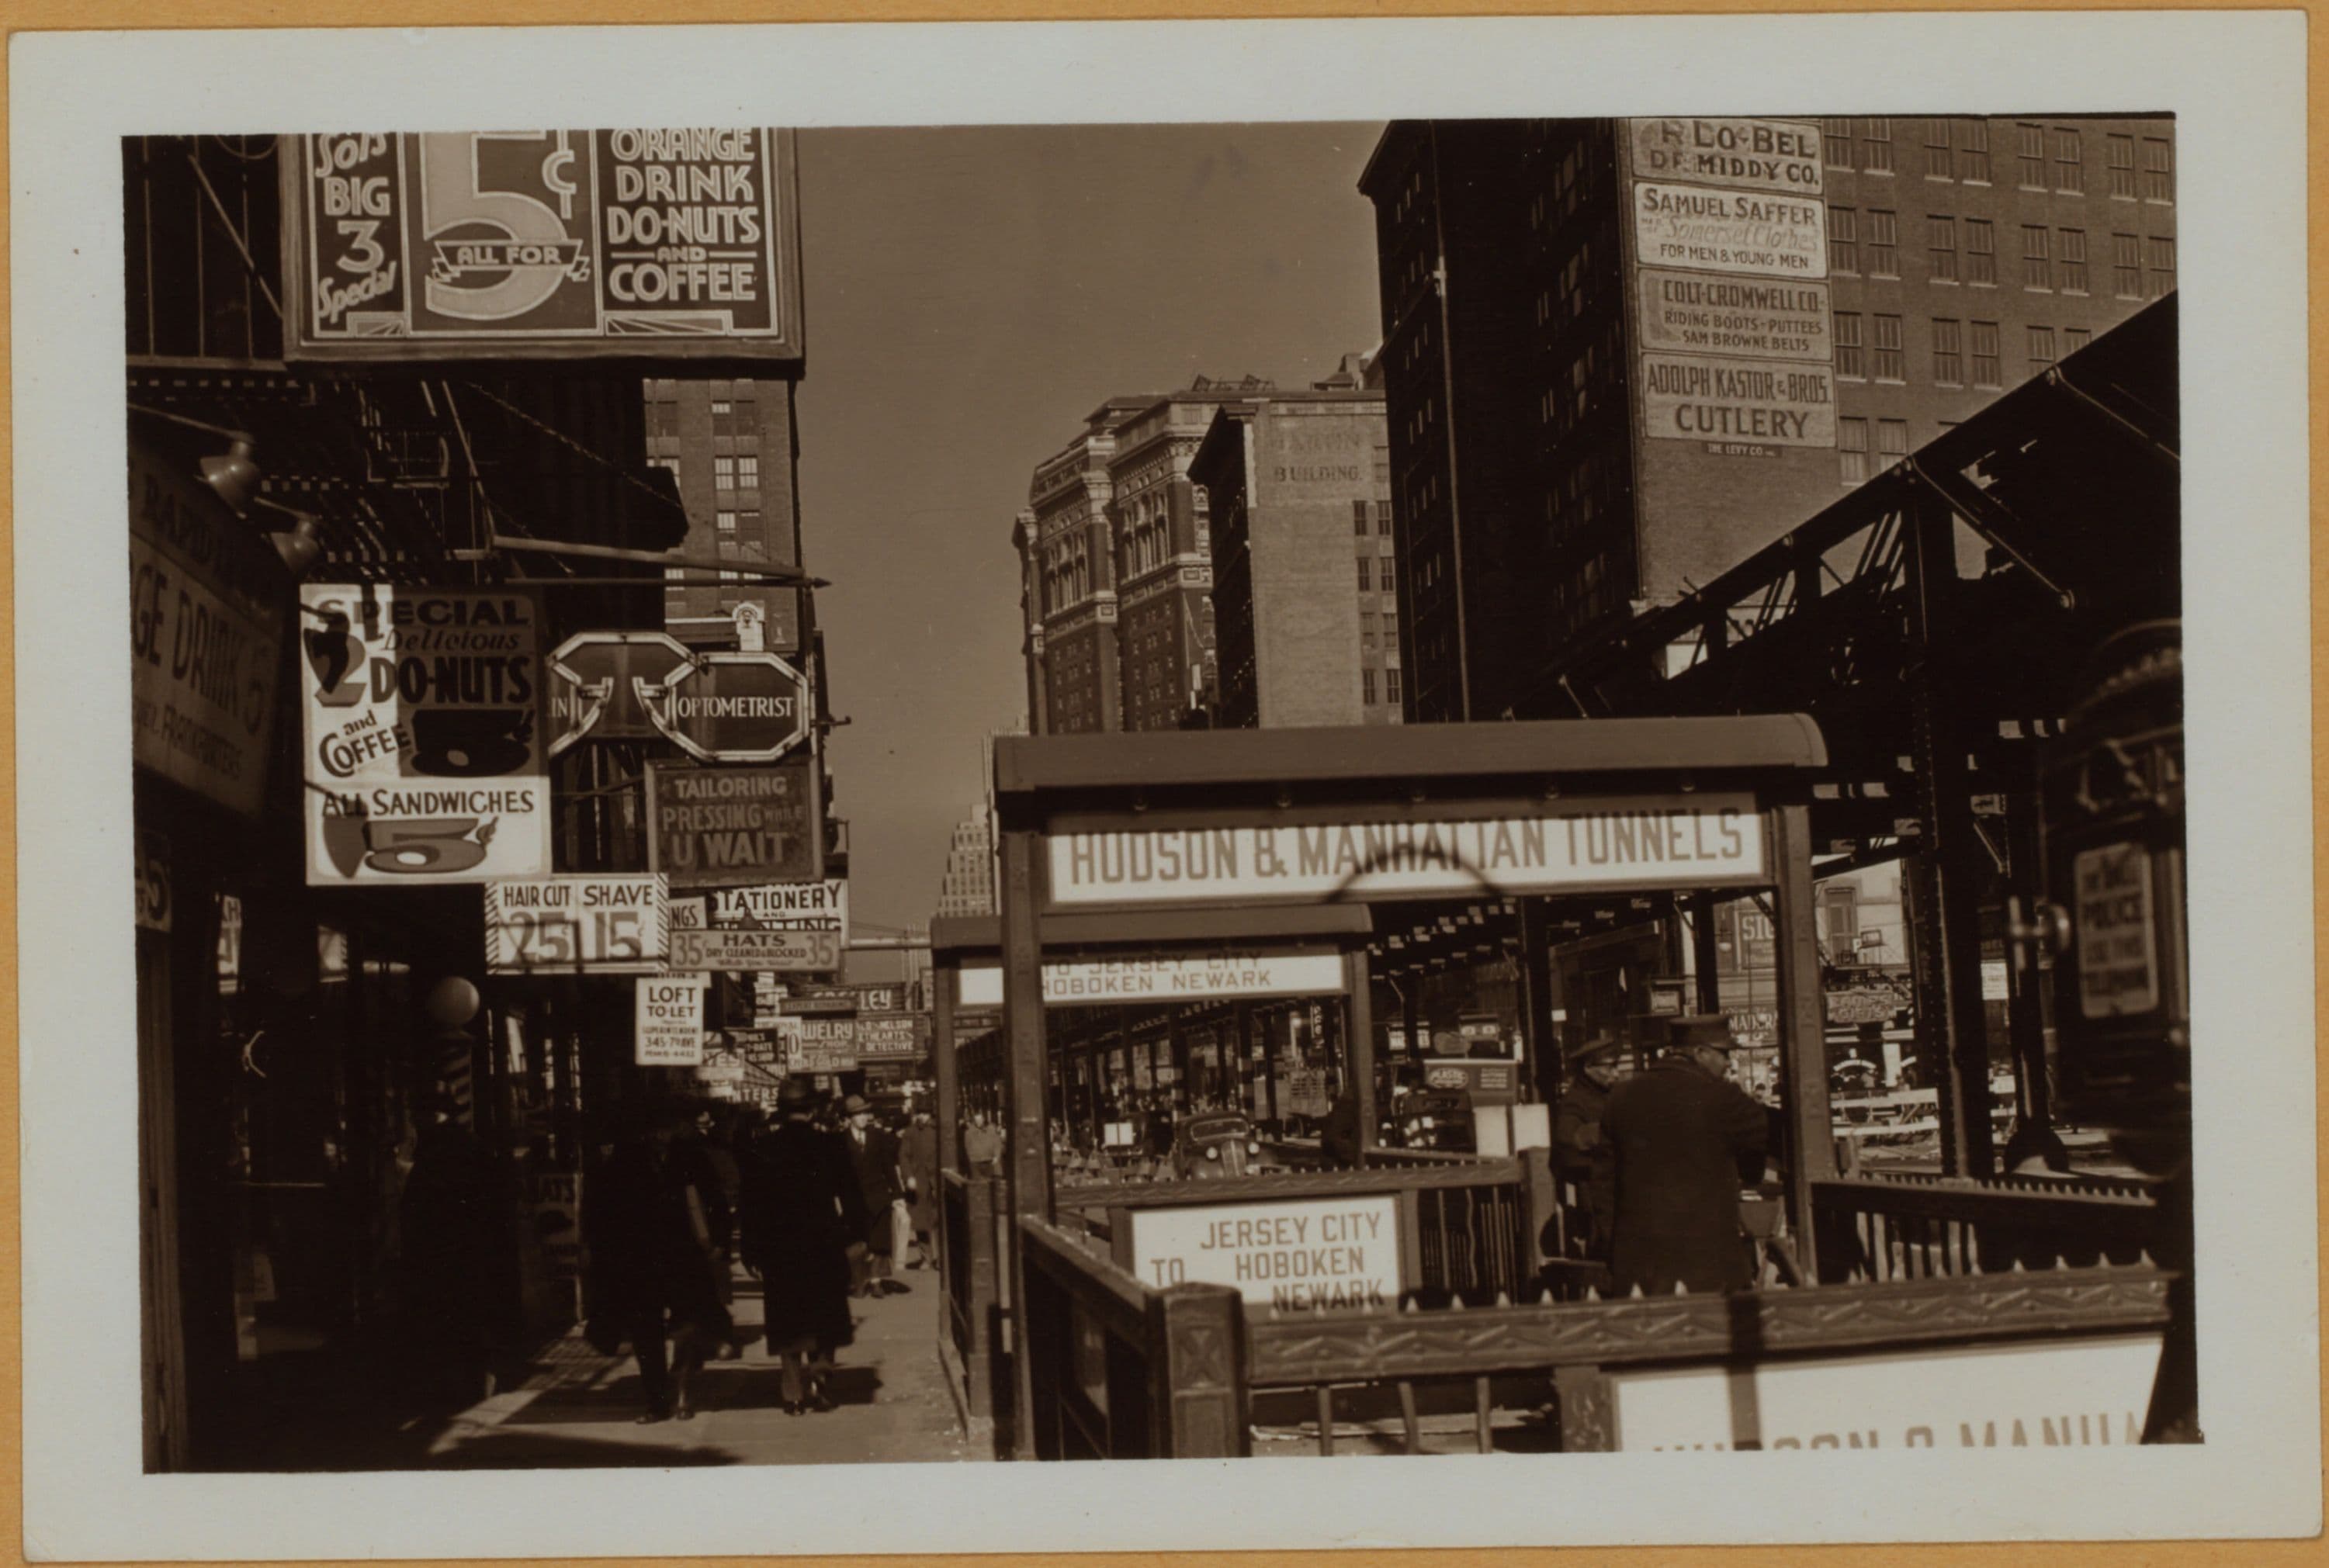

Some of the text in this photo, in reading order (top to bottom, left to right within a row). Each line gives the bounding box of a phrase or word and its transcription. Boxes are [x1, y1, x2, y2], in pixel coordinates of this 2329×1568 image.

[609, 130, 756, 161] ORANGE
[616, 165, 754, 202] DRINK
[1697, 154, 1780, 181] MIDDY
[1787, 163, 1820, 186] CO.
[324, 176, 390, 216] BIG
[1642, 188, 1817, 227] SAMUEL SAFFER
[337, 220, 385, 273] 3
[456, 246, 561, 265] ALL FOR
[656, 246, 707, 263] AND
[1660, 244, 1809, 270] FOR MEN & YOUNG MEN
[318, 261, 397, 324] Special
[609, 264, 756, 301] COFFEE
[1665, 310, 1710, 327] RIDING
[1683, 330, 1810, 354] SAM BROWNE BELTS
[1646, 362, 1710, 396] ADOLPH
[1714, 367, 1777, 401] KASTOR
[1674, 403, 1810, 440] CUTLERY
[318, 599, 529, 626] SPECIAL
[383, 629, 519, 652] Delicious
[369, 656, 532, 704] DO-NUTS
[676, 697, 794, 718] OPTOMETRIST
[342, 709, 378, 736] and
[319, 723, 414, 777] COFFEE
[673, 776, 787, 800] TAILORING
[322, 788, 534, 818] ALL SANDWICHES
[662, 804, 762, 831] PRESSING
[671, 830, 791, 867] U WAIT
[1071, 808, 1742, 886] HUDSON & MANHATTAN TUNNELS
[504, 884, 572, 907] HAIR CUT
[583, 884, 653, 906] SHAVE
[705, 948, 722, 958] DRY
[767, 947, 807, 958] BLOCKED
[723, 933, 786, 947] HATS
[1088, 954, 1186, 974] JERSEY
[1208, 952, 1263, 971] CITY
[648, 985, 697, 1003] LOFT
[1173, 969, 1272, 991] NEWARK
[1201, 1211, 1381, 1250] JERSEY CITY
[1151, 1246, 1364, 1288] TO HOBOKEN
[1270, 1279, 1385, 1312] NEWARK
